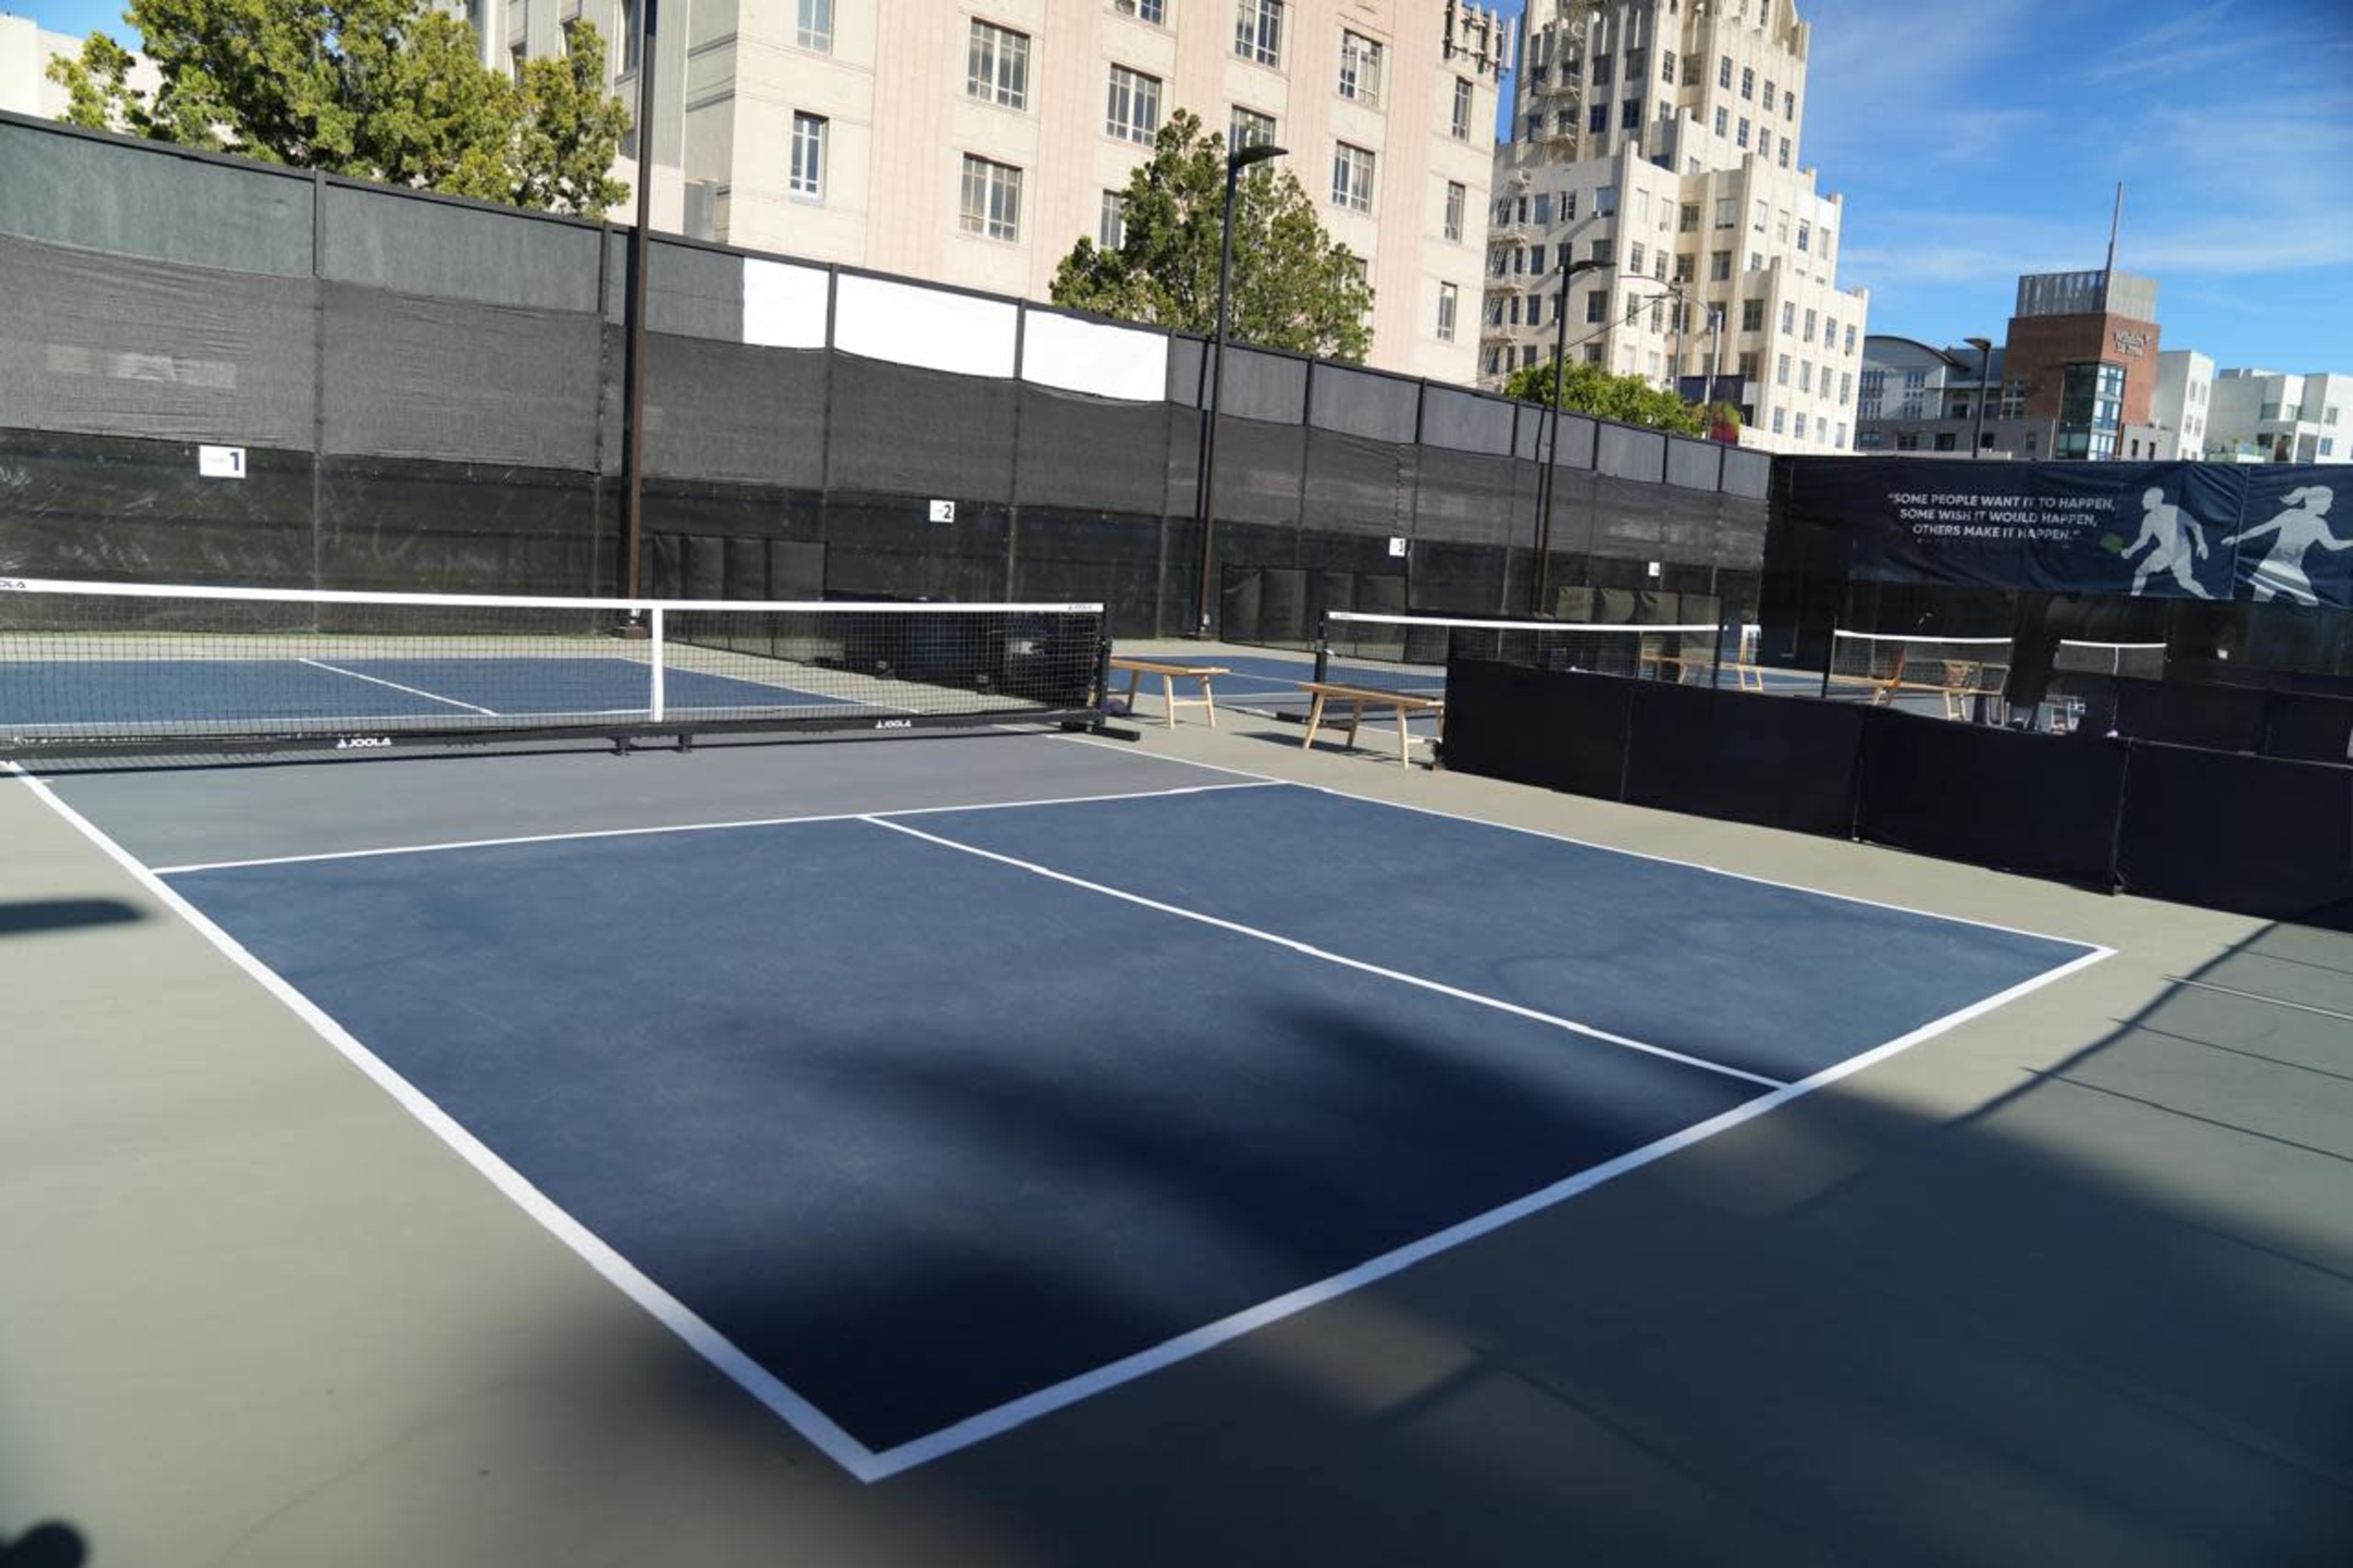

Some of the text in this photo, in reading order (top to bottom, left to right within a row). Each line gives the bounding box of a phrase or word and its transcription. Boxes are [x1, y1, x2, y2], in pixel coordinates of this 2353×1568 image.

[229, 452, 240, 471] 1
[1931, 494, 1978, 506] PEOPLE
[1980, 495, 2020, 507] WANT
[2023, 497, 2034, 508] IT
[2038, 497, 2056, 509] TO
[2058, 497, 2115, 511] HAPPEN,
[944, 504, 952, 519] 2
[1900, 509, 1935, 519] SOME
[1939, 509, 1971, 521] WISH
[1974, 510, 1986, 521] IT
[1988, 510, 2037, 523] WOULD
[1912, 524, 1961, 536] OTHERS
[1963, 526, 2001, 537] MAKE
[2003, 528, 2015, 538] IT
[347, 737, 392, 747] JOOLA
